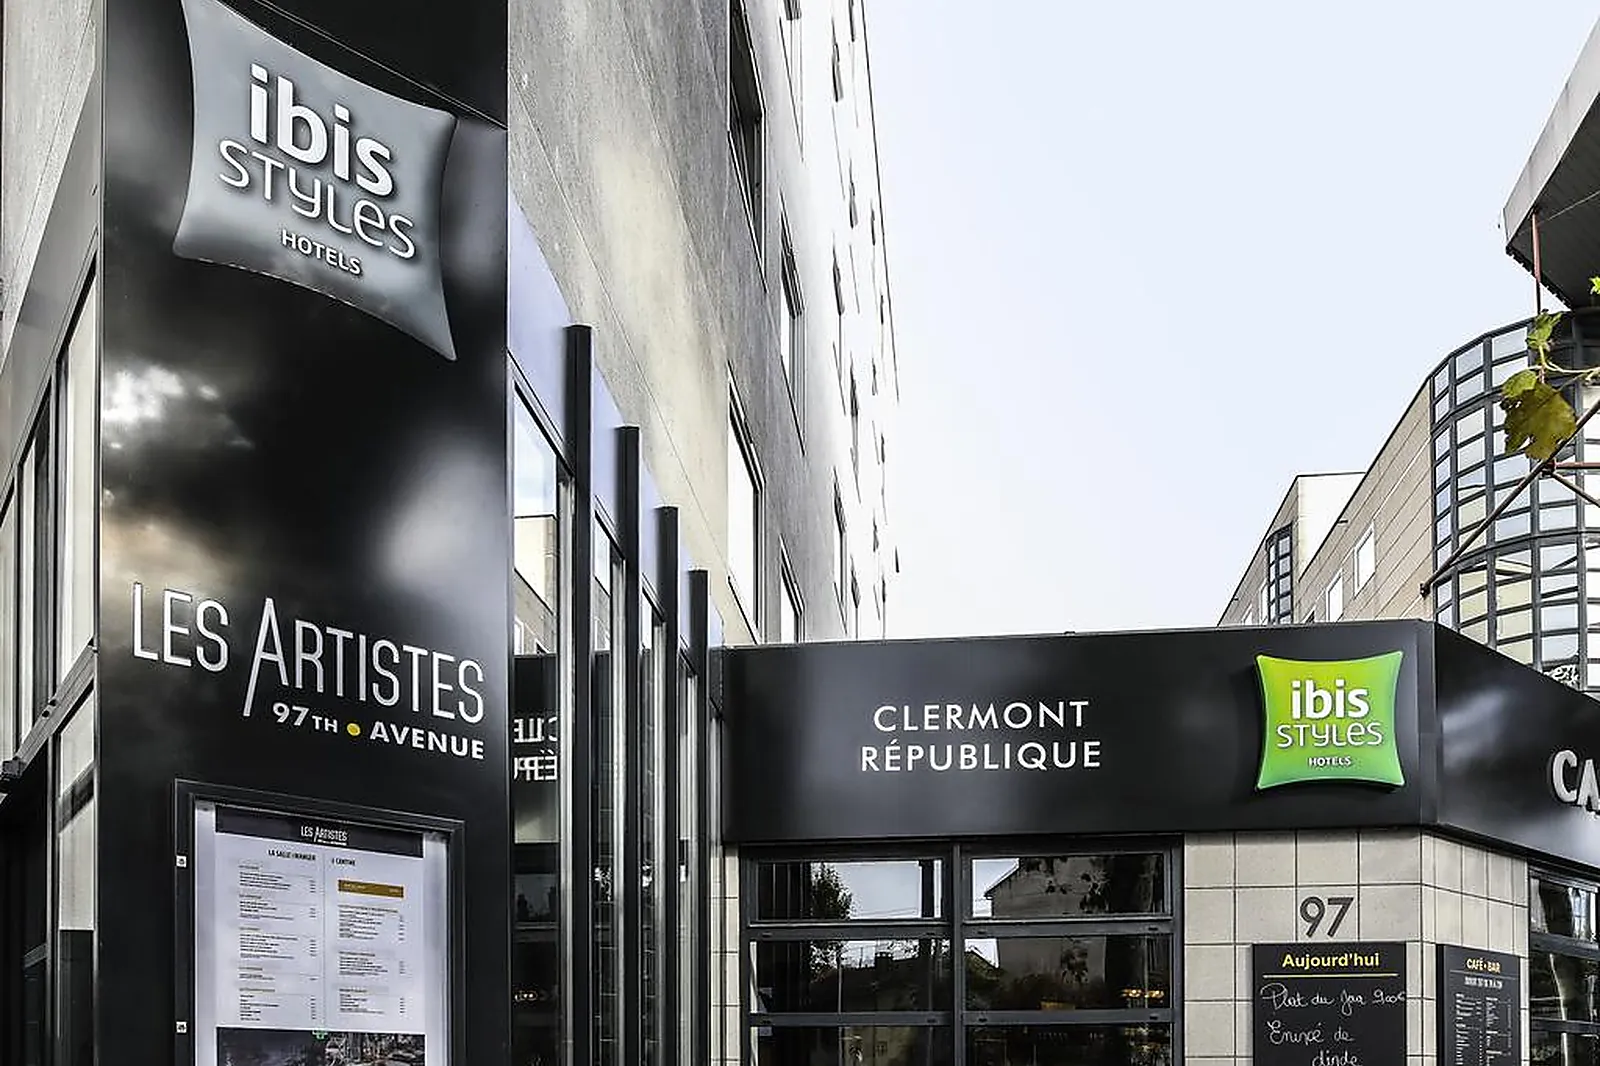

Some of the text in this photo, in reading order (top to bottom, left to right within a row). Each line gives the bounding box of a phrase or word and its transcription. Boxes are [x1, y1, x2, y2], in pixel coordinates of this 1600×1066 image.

[250, 63, 394, 196] ibis
[281, 229, 362, 275] HOTELS
[132, 582, 485, 724] LES ARTISTES
[873, 701, 1089, 732] CLERMONT
[1291, 679, 1370, 719] ibis
[369, 721, 485, 759] AVENUE
[861, 738, 1101, 771] RÉPUBLIQUE
[1308, 755, 1352, 767] HOTELS
[1300, 896, 1354, 938] 97
[1282, 952, 1380, 970] Aujourd'hui
